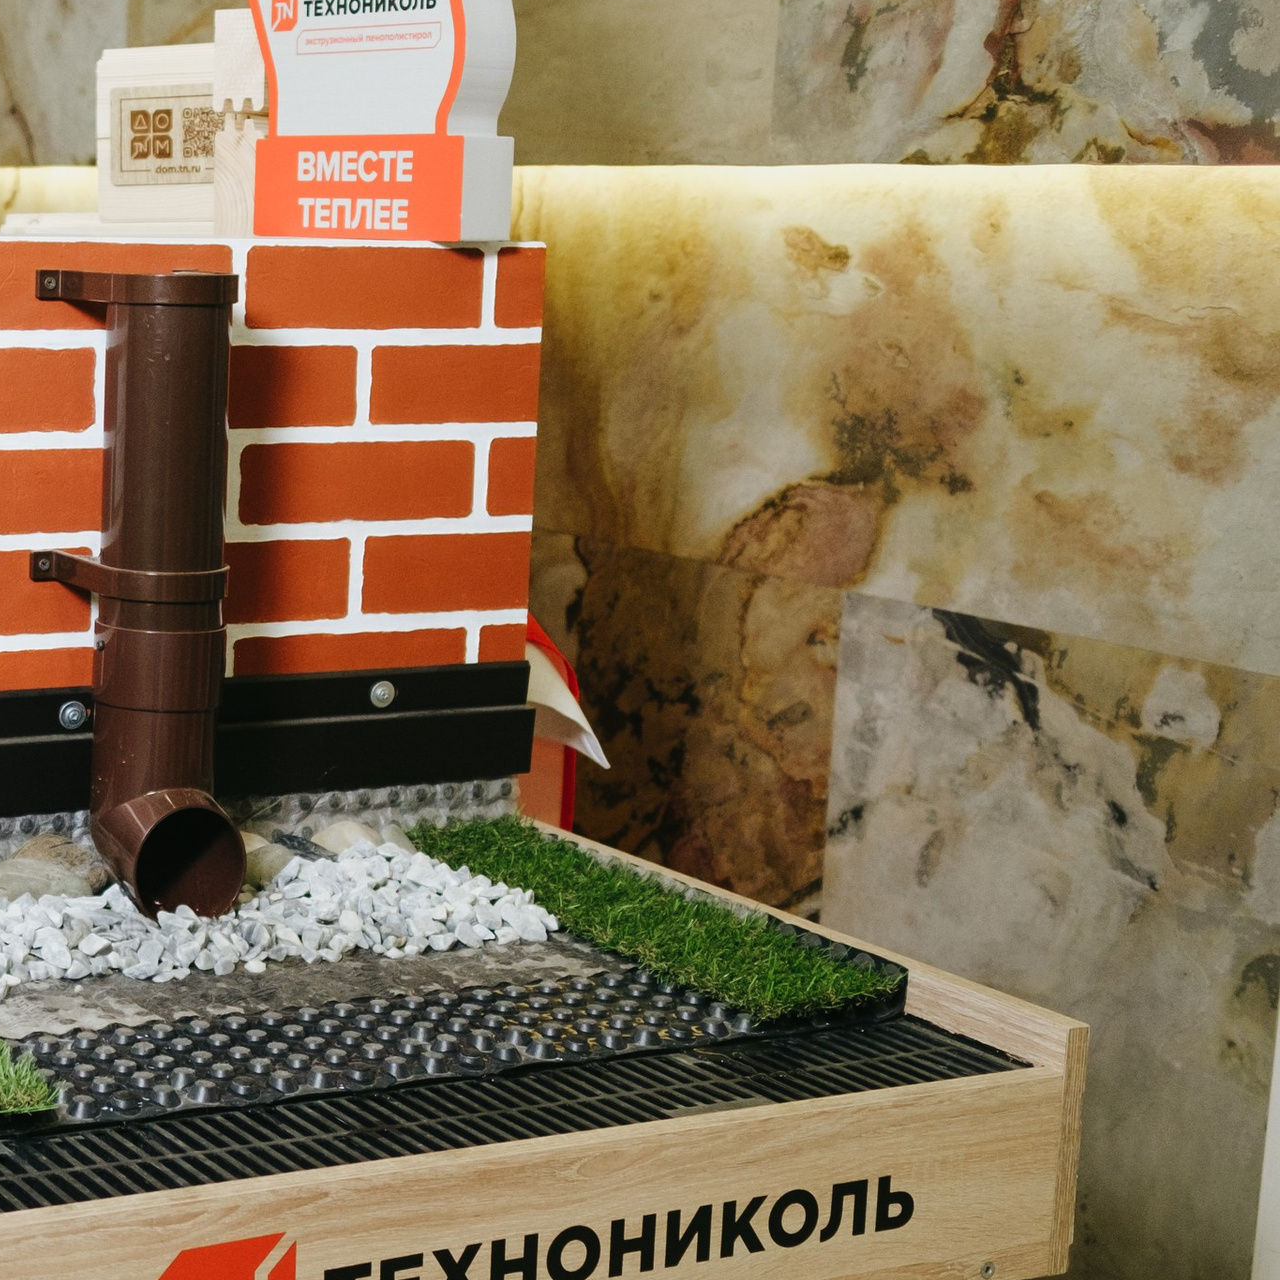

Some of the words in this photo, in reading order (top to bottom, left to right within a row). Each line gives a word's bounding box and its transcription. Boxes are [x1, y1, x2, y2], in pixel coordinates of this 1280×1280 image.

[305, 34, 364, 46] экструзионный
[365, 31, 433, 43] пенополистирол
[155, 165, 201, 174] dom.tn.ru
[297, 150, 413, 182] ВМЕСТЕ
[298, 197, 409, 230] ТЕПЛЕЕ
